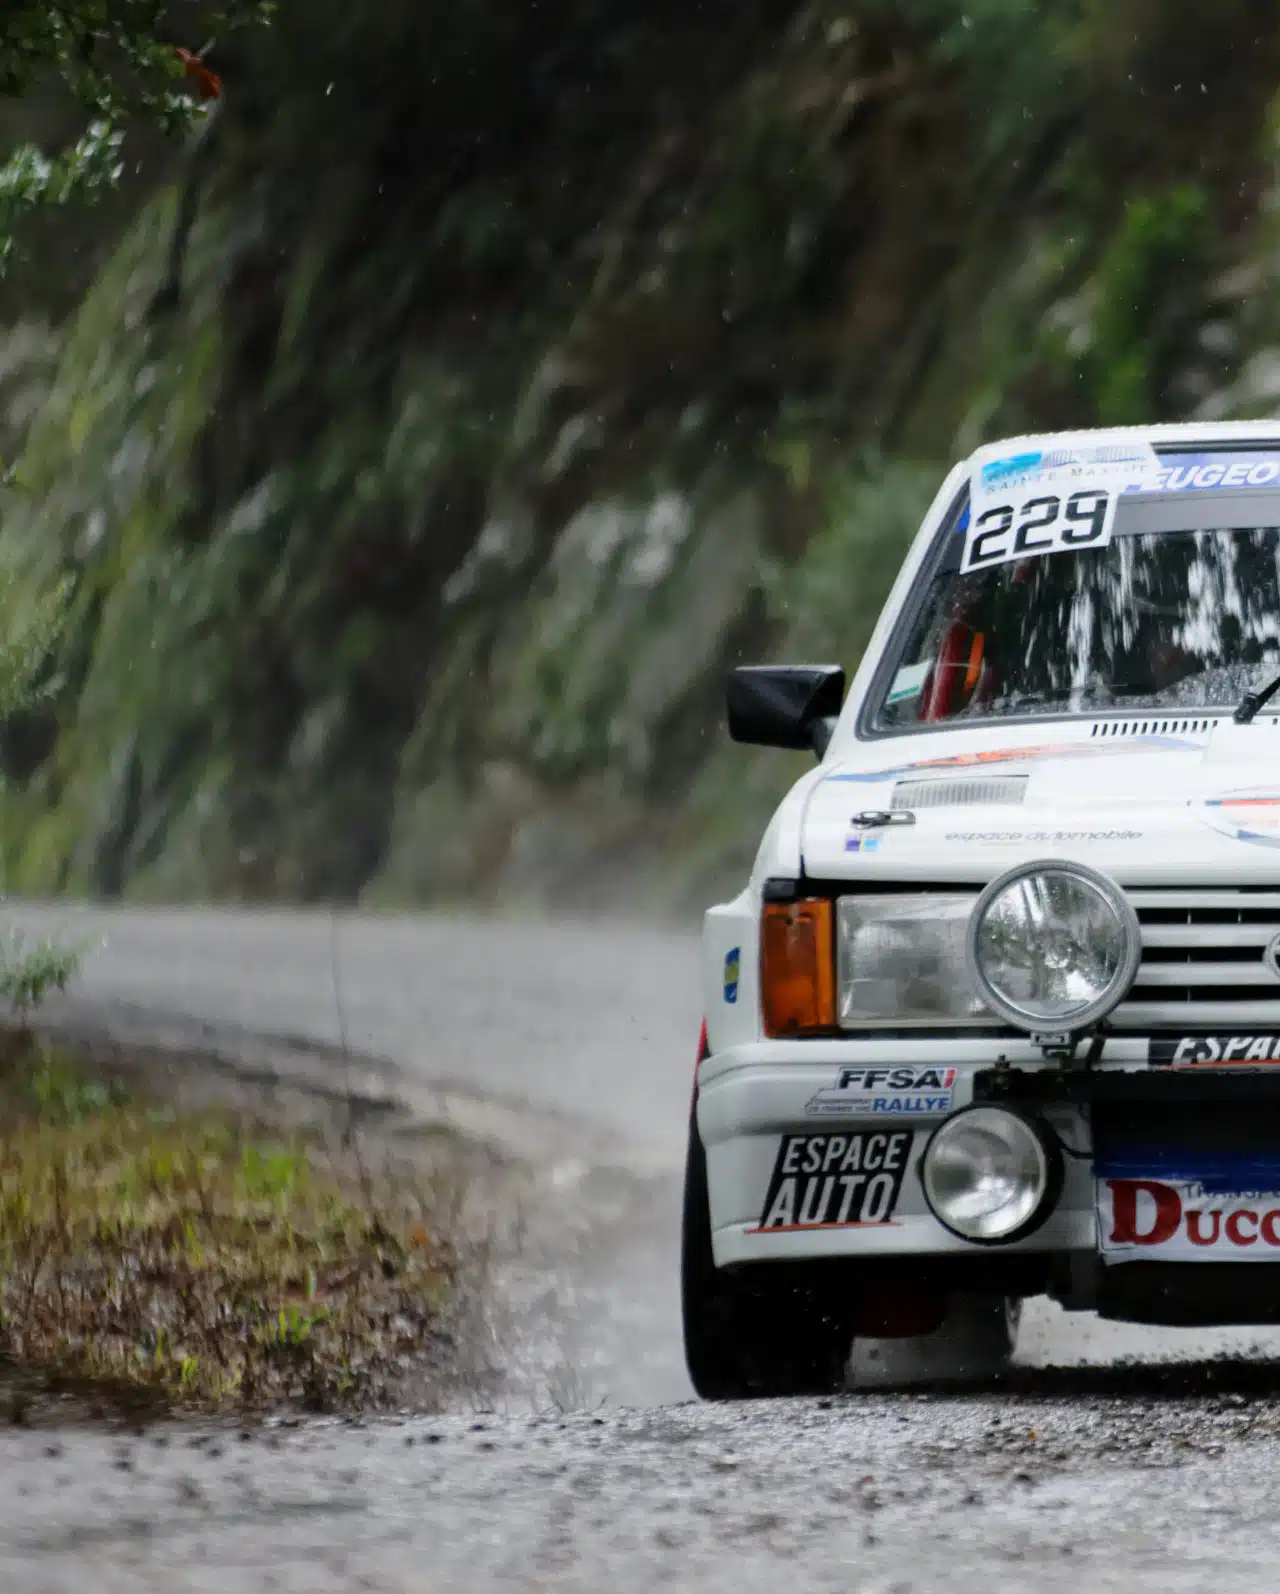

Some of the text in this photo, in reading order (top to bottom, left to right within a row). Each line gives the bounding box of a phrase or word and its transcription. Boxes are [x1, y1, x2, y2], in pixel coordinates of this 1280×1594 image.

[969, 489, 1109, 564] 229
[837, 1068, 942, 1090] FFSA
[872, 1097, 950, 1112] RALLYE
[782, 1133, 906, 1174] ESPACE
[762, 1173, 897, 1228] AUTO
